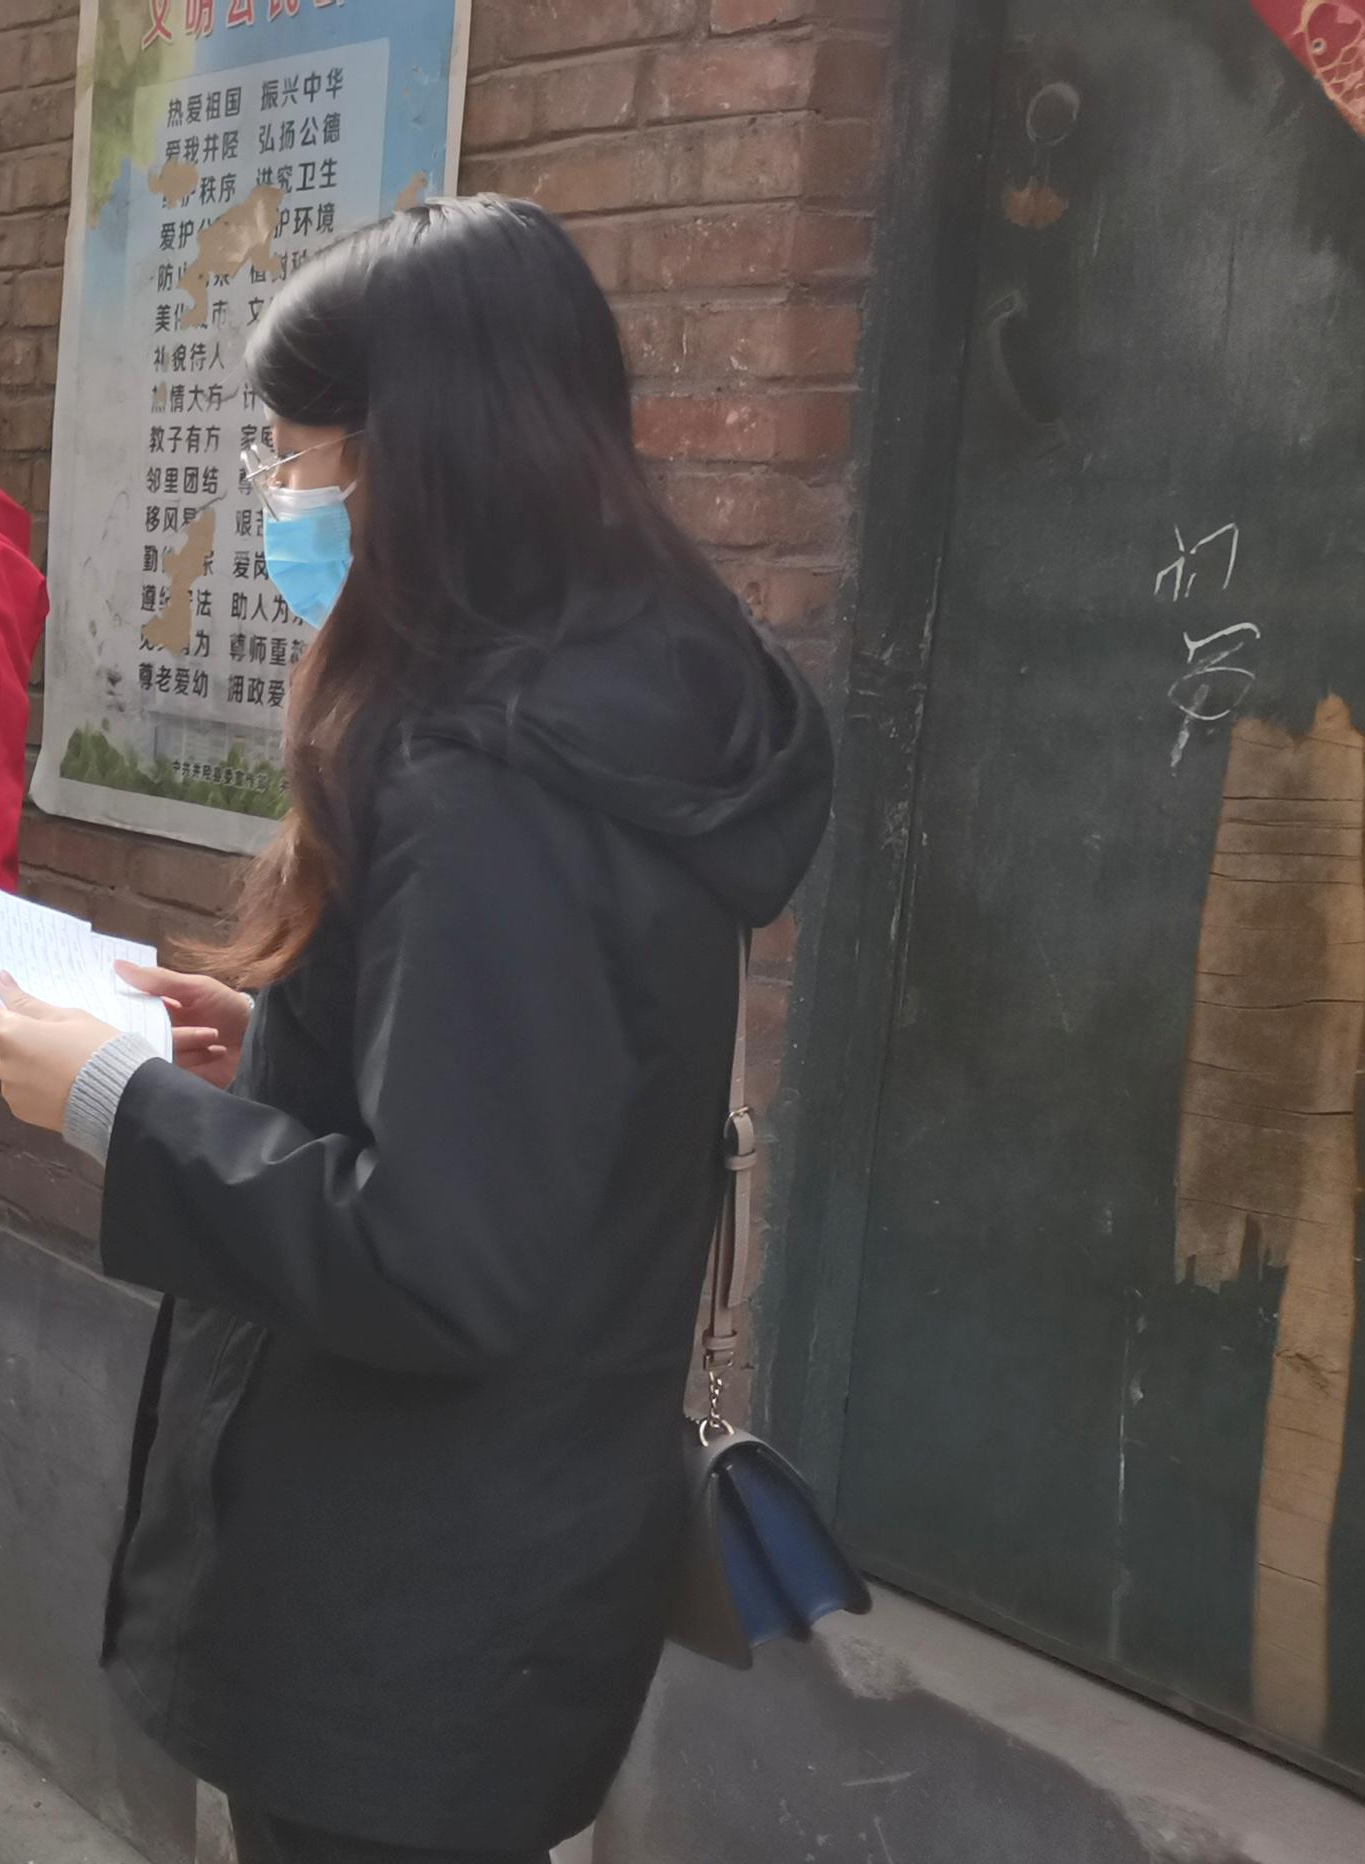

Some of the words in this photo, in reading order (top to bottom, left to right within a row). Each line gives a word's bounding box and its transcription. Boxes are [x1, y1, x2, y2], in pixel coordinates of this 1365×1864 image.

[167, 86, 242, 128] 热爱祖国
[260, 67, 343, 112] 振兴中华
[165, 130, 239, 164] 爱我井陉
[258, 112, 340, 154] 弘扬公德
[154, 300, 229, 333] 美化市
[149, 425, 221, 453] 教子有方
[146, 467, 219, 494] 邻里团结
[145, 506, 198, 533] 移风易
[231, 591, 303, 625] 助人为
[138, 663, 209, 698] 尊老爱幼
